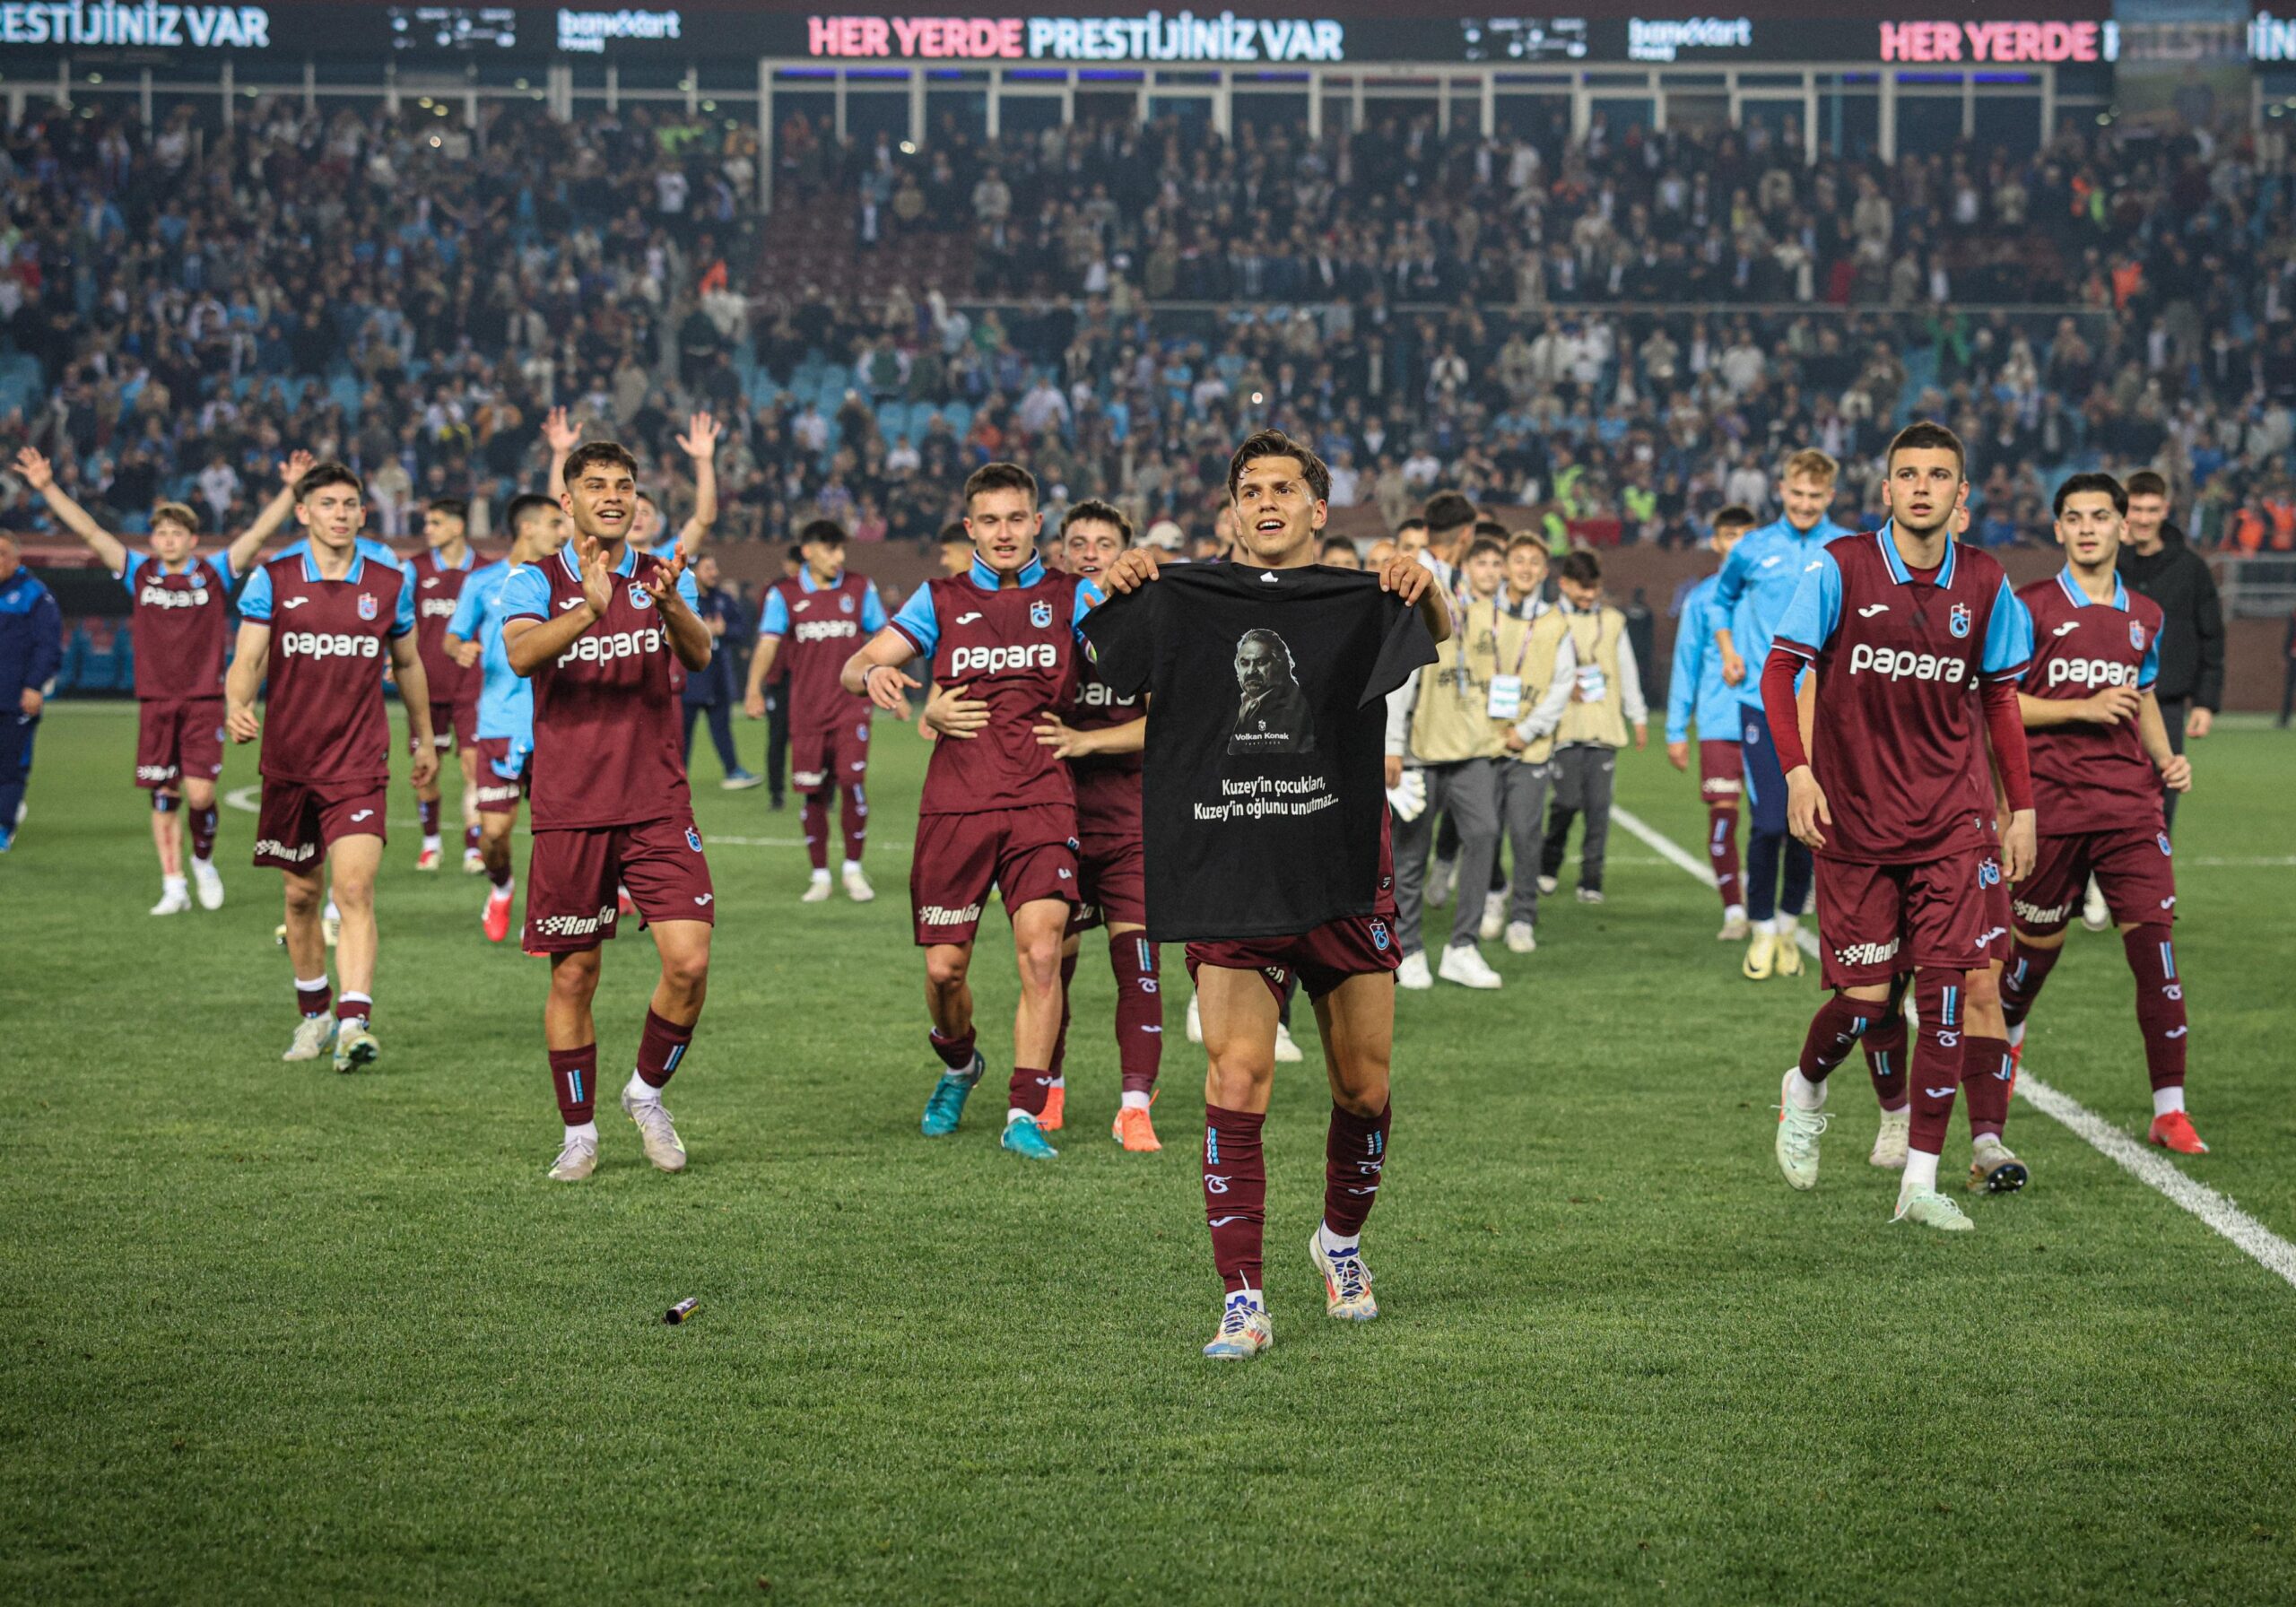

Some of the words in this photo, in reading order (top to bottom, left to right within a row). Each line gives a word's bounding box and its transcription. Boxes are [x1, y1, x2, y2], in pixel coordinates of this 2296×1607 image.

[0, 0, 182, 44] ESTİJİNİZ
[183, 5, 269, 47] VAR
[808, 16, 891, 56] HER
[891, 17, 1024, 57] YERDE
[1028, 10, 1257, 60] PRESTİJİNİZ
[1258, 19, 1344, 61] VAR
[1879, 21, 1962, 61] HER
[1963, 21, 2099, 62] YERDE
[141, 586, 209, 610] papara
[282, 630, 379, 661] papara
[796, 621, 857, 643] papara
[952, 643, 1057, 678] papara
[1849, 643, 1966, 683] papara
[1264, 732, 1289, 740] Konak
[1222, 776, 1272, 797] Kuzey'in
[1274, 775, 1326, 796] çocukları,
[1194, 801, 1244, 821] Kuzey'in
[1246, 797, 1288, 819] oğlunu
[1291, 794, 1339, 815] unutmaz...
